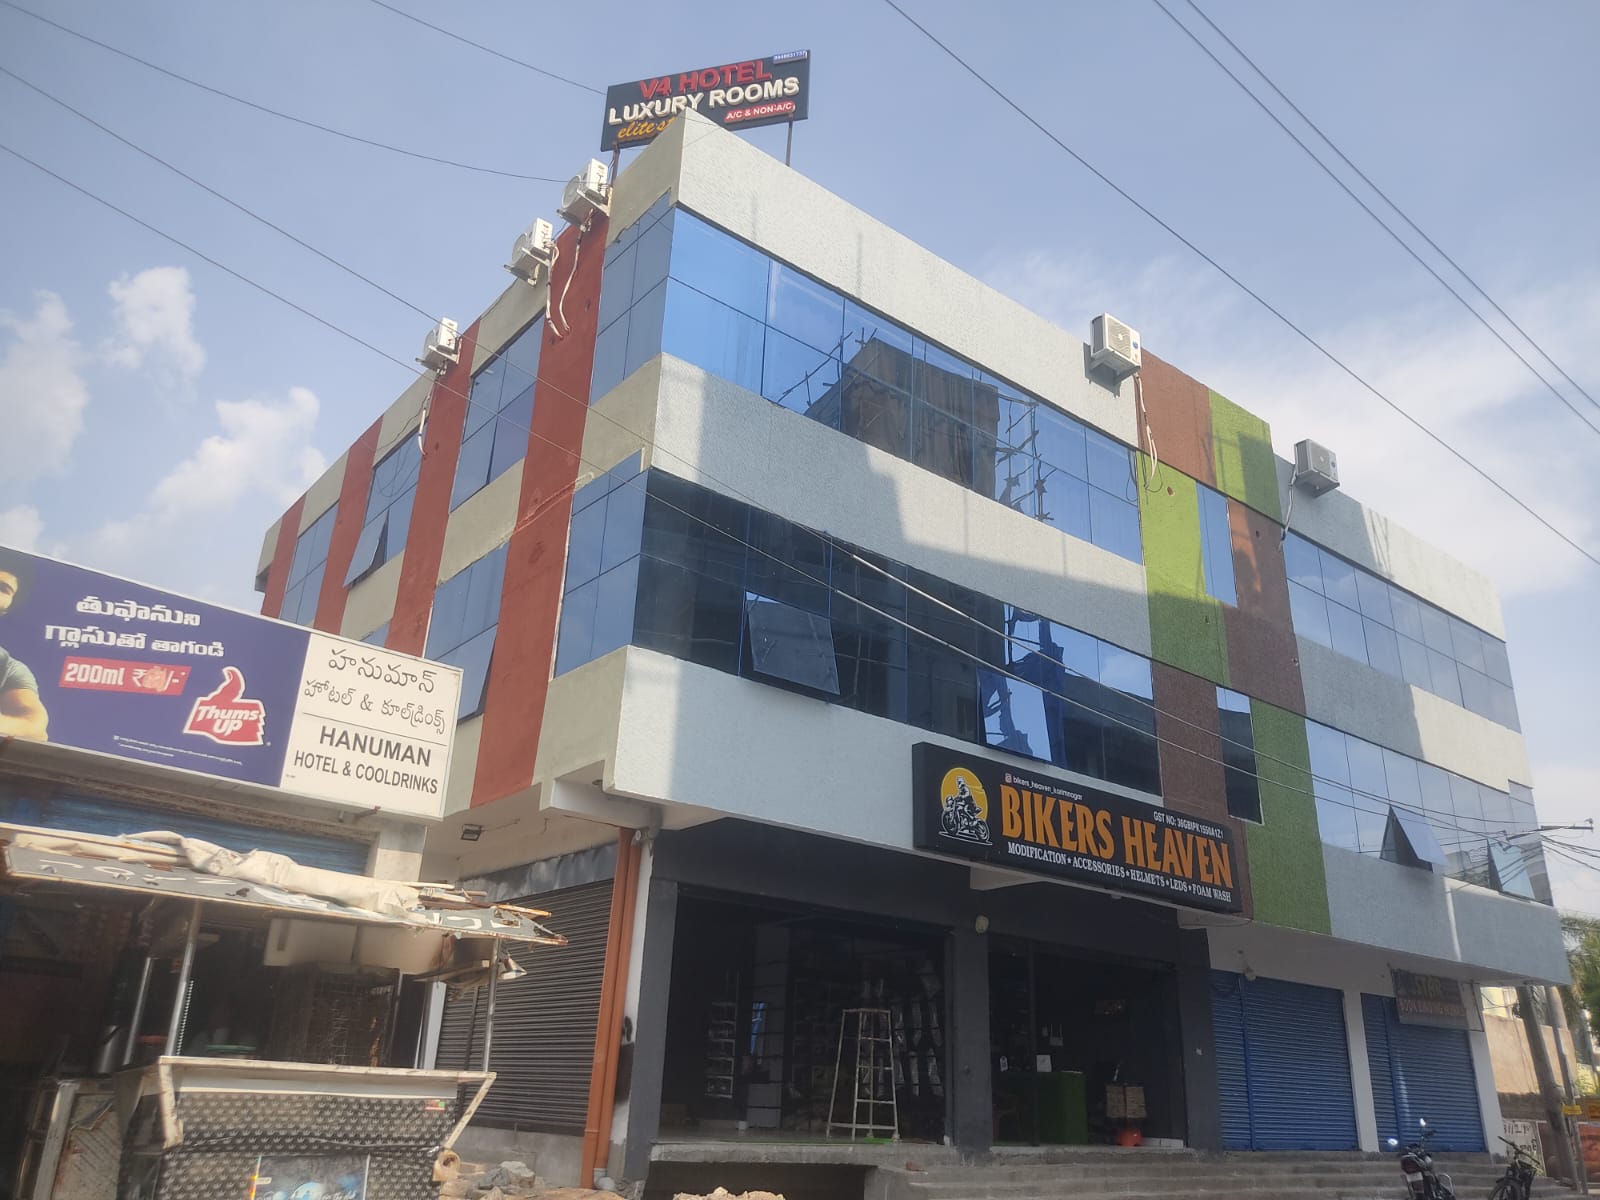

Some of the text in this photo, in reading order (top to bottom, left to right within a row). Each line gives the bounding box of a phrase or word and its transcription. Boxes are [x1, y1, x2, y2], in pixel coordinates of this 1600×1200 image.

[639, 61, 771, 99] V4 HOTEL
[608, 78, 799, 124] LUXURY ROOMS
[726, 110, 742, 121] A/C
[744, 109, 752, 117] &
[45, 625, 225, 658] గ్లాసుతో తాగండి
[64, 663, 125, 686] 200ml
[328, 649, 436, 692] హనుమాన్
[196, 705, 259, 722] Thums
[304, 680, 355, 705] హోటల్
[360, 693, 374, 712] &
[319, 726, 431, 767] HANUMAN
[294, 751, 438, 794] HOTEL & COOLDRINKS
[1000, 784, 1232, 888] BIKERS HEAVEN
[1153, 811, 1165, 823] GST
[1007, 842, 1232, 903] MODIFICATION ACCESSORIES HELMETS LEDS FOAM WASH
